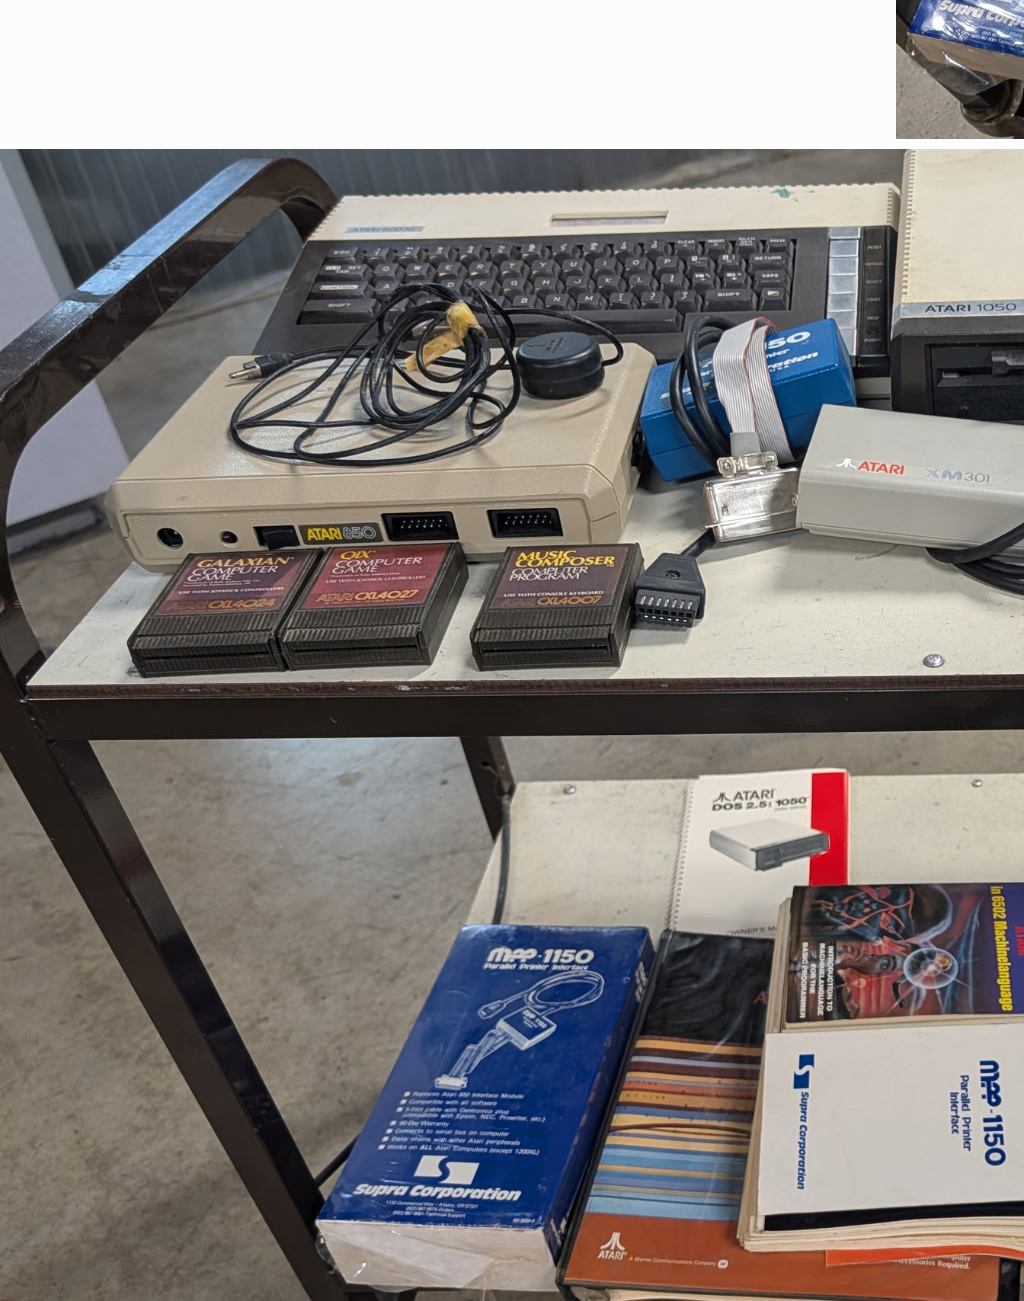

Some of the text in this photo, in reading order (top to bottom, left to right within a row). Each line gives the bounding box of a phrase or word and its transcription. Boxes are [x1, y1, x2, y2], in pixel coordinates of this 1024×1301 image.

[938, 0, 984, 19] Supra
[925, 302, 1017, 314] ATARI 1050
[857, 460, 991, 484] ATARI XM301
[306, 525, 377, 542] ATARI 850
[339, 550, 372, 560] QIX
[517, 550, 577, 560] MUSIC
[196, 556, 292, 568] GALAXIAN
[335, 556, 424, 568] COMPUTER
[515, 556, 616, 568] COMPOSER
[191, 565, 279, 576] COMPUTER
[331, 566, 379, 574] GAME
[511, 566, 589, 576] COMPUTER
[187, 573, 234, 582] GAME
[509, 573, 581, 582] PROGRAM
[315, 589, 420, 602] ATARI CXL4027
[537, 596, 603, 606] CXL4007
[207, 598, 276, 610] CXL4024
[733, 789, 774, 801] ATARI
[712, 803, 742, 812] DOS
[775, 797, 808, 807] 1050
[989, 886, 1014, 1012] in 6502 Machinelanguage
[483, 962, 517, 970] Parallel
[519, 963, 550, 971] Printer
[826, 945, 834, 1012] INTRODUCTION TO
[949, 1091, 961, 1136] Interface
[959, 1074, 972, 1152] Parallel Printer
[796, 1090, 810, 1191] Supra Corporation
[353, 1183, 522, 1202] Supra Corporation
[937, 1260, 971, 1270] Required.
